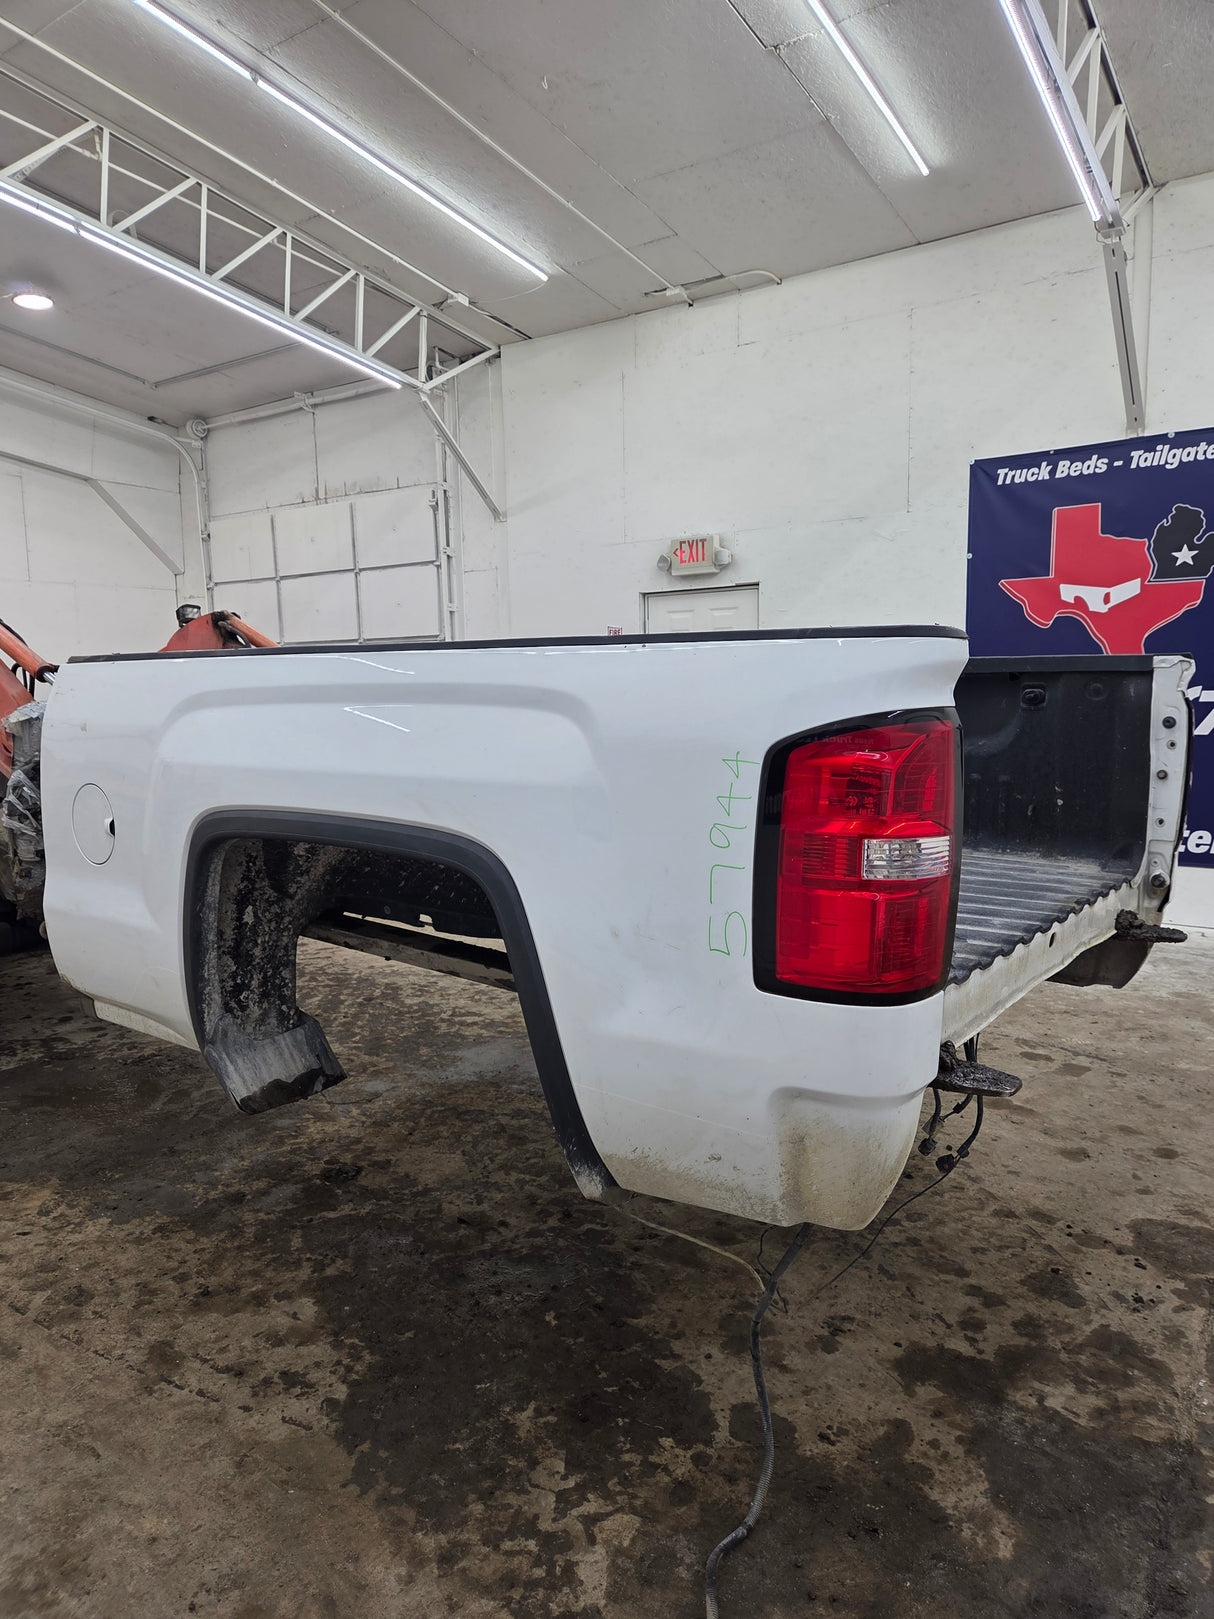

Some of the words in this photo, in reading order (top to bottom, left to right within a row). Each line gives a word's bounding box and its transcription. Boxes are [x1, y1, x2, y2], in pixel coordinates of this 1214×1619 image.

[997, 461, 1053, 485] Truck
[1055, 454, 1109, 478] Beds
[680, 538, 707, 564] EXIT
[709, 751, 760, 957] 57944
